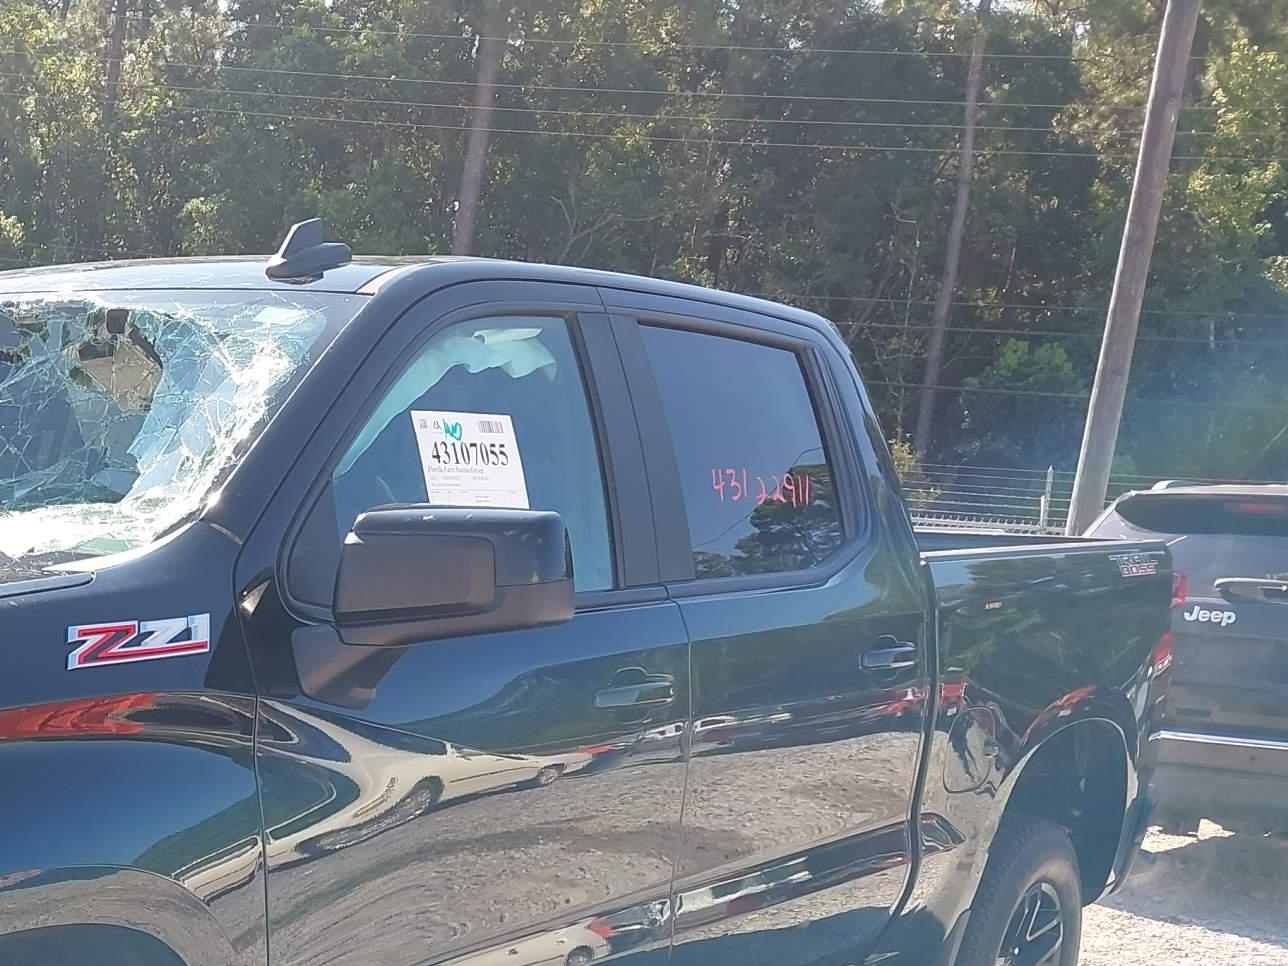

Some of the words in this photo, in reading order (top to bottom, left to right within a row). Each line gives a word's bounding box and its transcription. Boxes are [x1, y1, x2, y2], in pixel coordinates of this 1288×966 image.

[432, 440, 509, 466] 43107055
[1120, 564, 1157, 578] BOSS
[1183, 604, 1237, 626] Jeep
[67, 613, 210, 670] Z71
